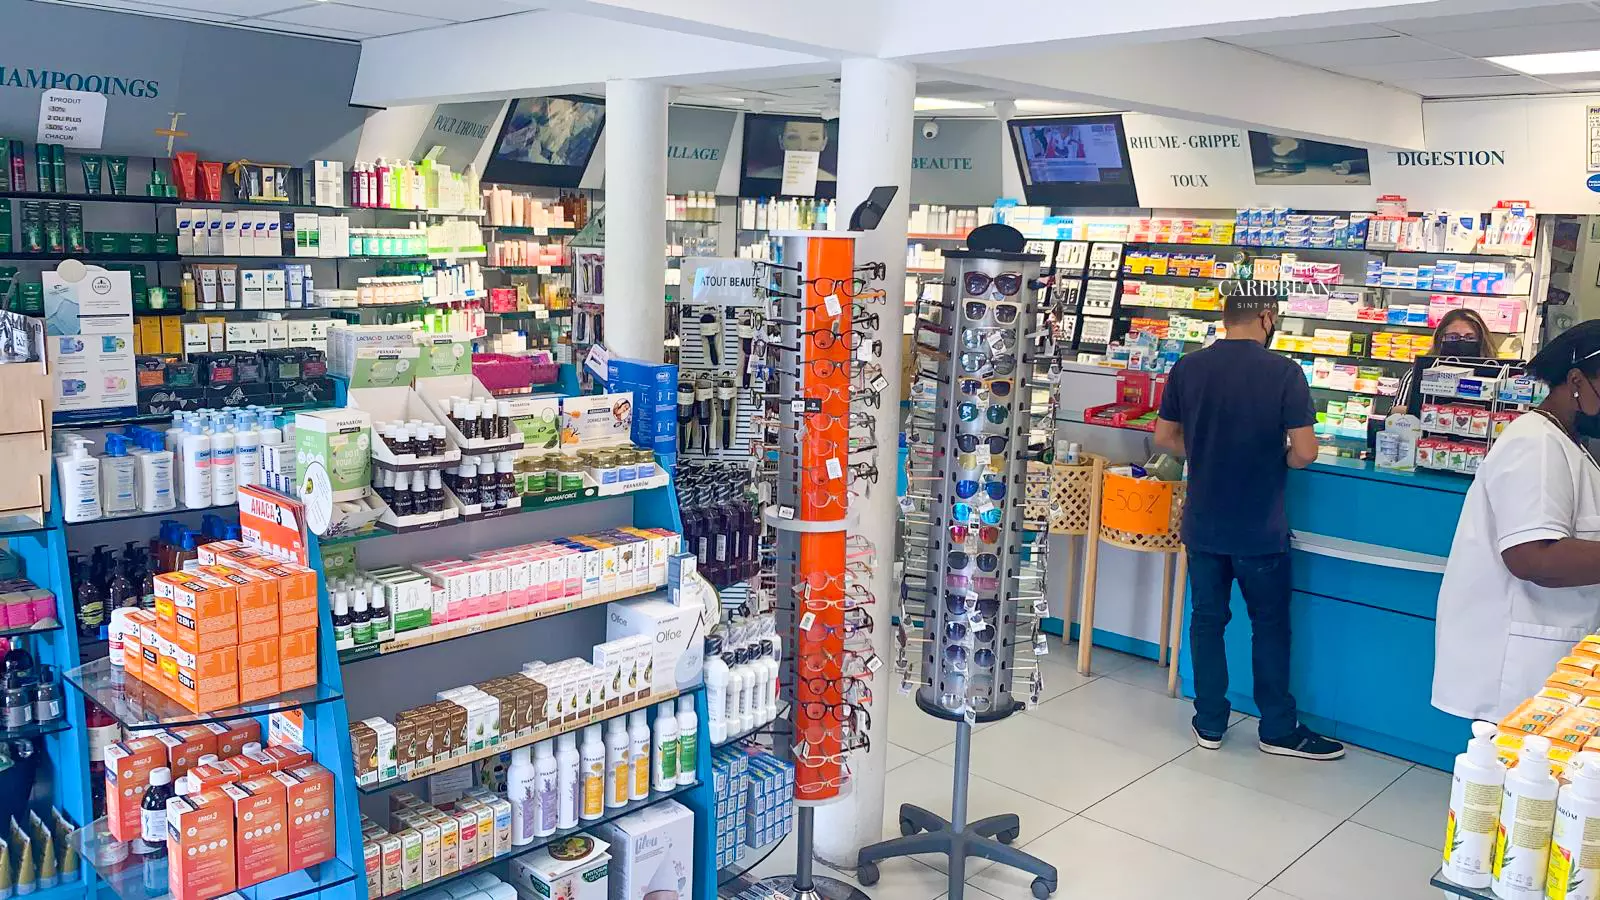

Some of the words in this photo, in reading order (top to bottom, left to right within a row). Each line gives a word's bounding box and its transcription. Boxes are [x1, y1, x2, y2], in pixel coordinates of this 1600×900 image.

[1129, 136, 1181, 150] RHUME
[1188, 133, 1241, 149] GRIPPE
[1396, 150, 1506, 167] DIGESTION
[1170, 173, 1210, 188] TOUX
[700, 276, 727, 287] ATOUT
[544, 491, 577, 503] AROMAFORCE
[250, 499, 276, 521] ANACA
[275, 503, 283, 527] 3
